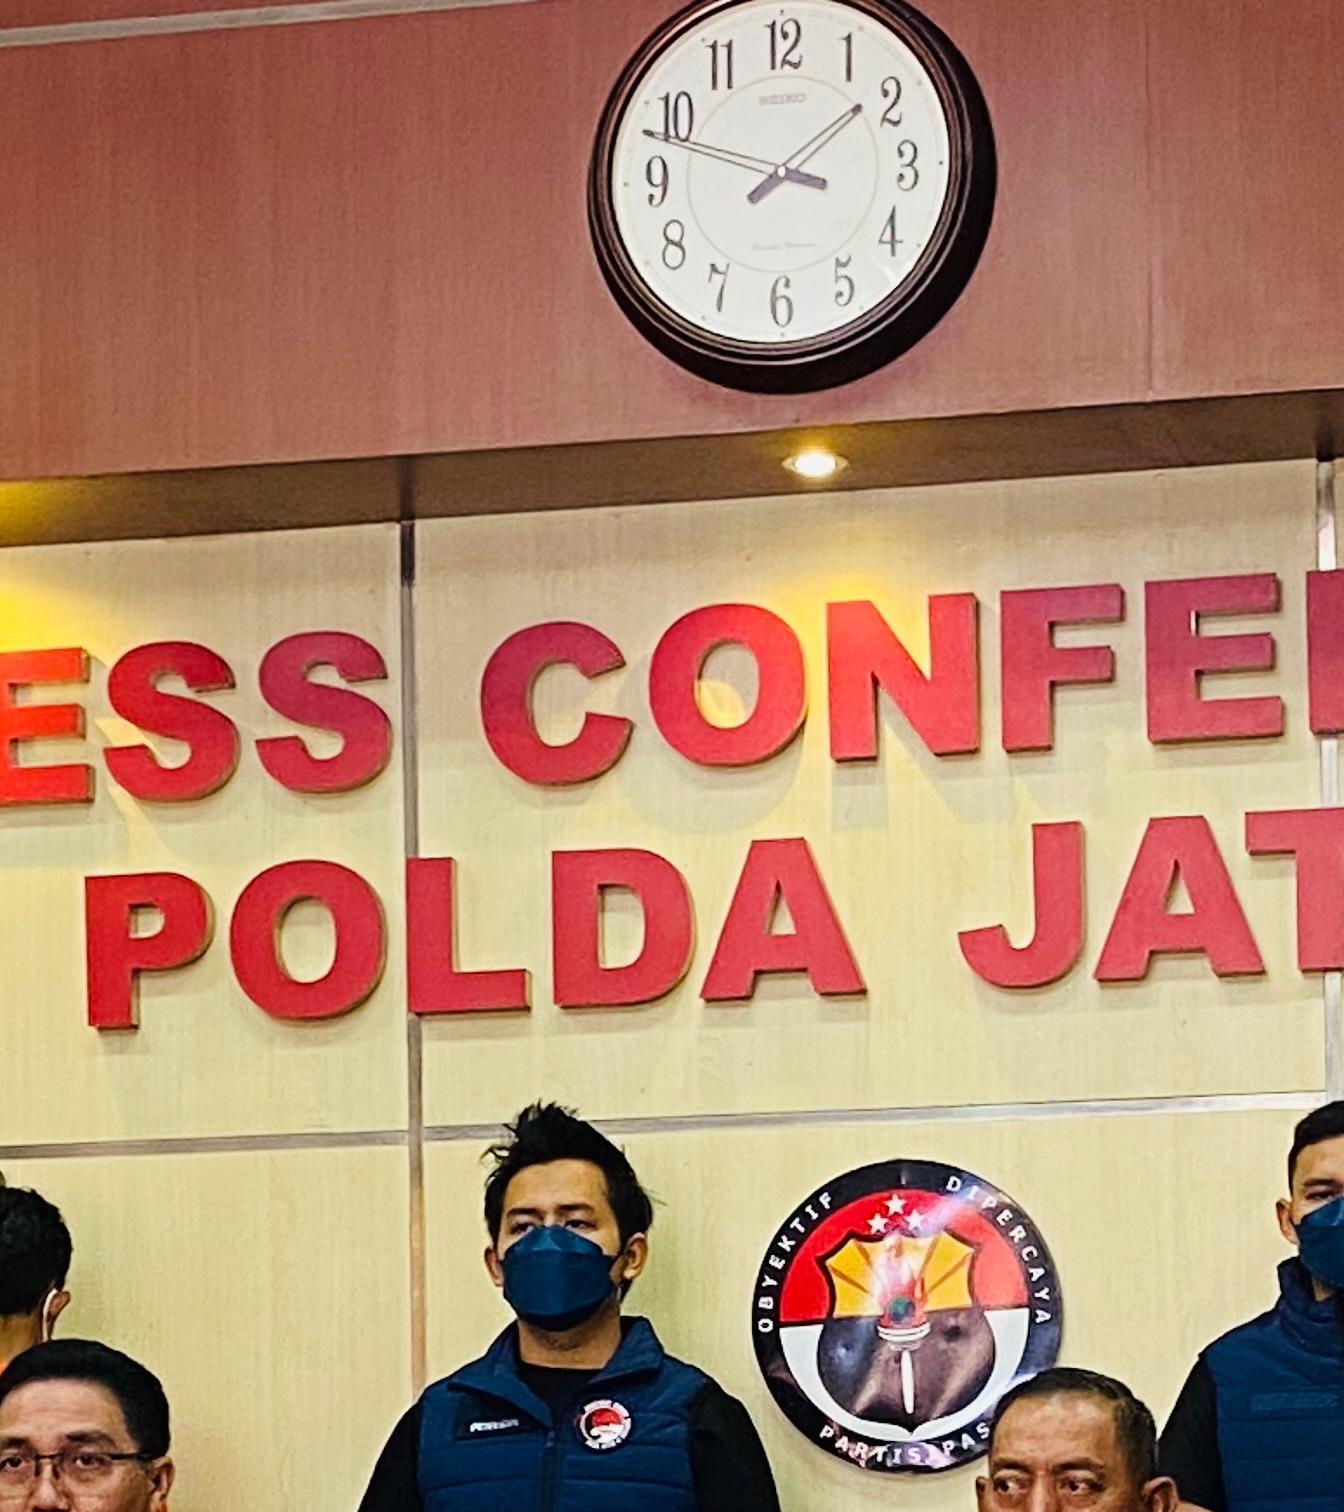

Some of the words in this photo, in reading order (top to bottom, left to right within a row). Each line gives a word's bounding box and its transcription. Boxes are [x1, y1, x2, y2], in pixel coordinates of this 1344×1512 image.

[705, 39, 734, 90] 11
[765, 18, 803, 71] 12
[840, 32, 853, 83] 1
[658, 91, 694, 142] 10
[880, 76, 902, 128] 2
[645, 155, 669, 208] 9
[896, 140, 918, 191] 3
[662, 219, 686, 270] 8
[878, 206, 903, 257] 4
[708, 262, 730, 312] 7
[770, 275, 793, 327] 6
[835, 255, 855, 307] 5
[84, 836, 868, 1031] POLDA
[758, 1192, 834, 1333] OBYEKTIF
[946, 1175, 1052, 1324] DIPERCAYA
[819, 1422, 992, 1463] PARTISPAS
